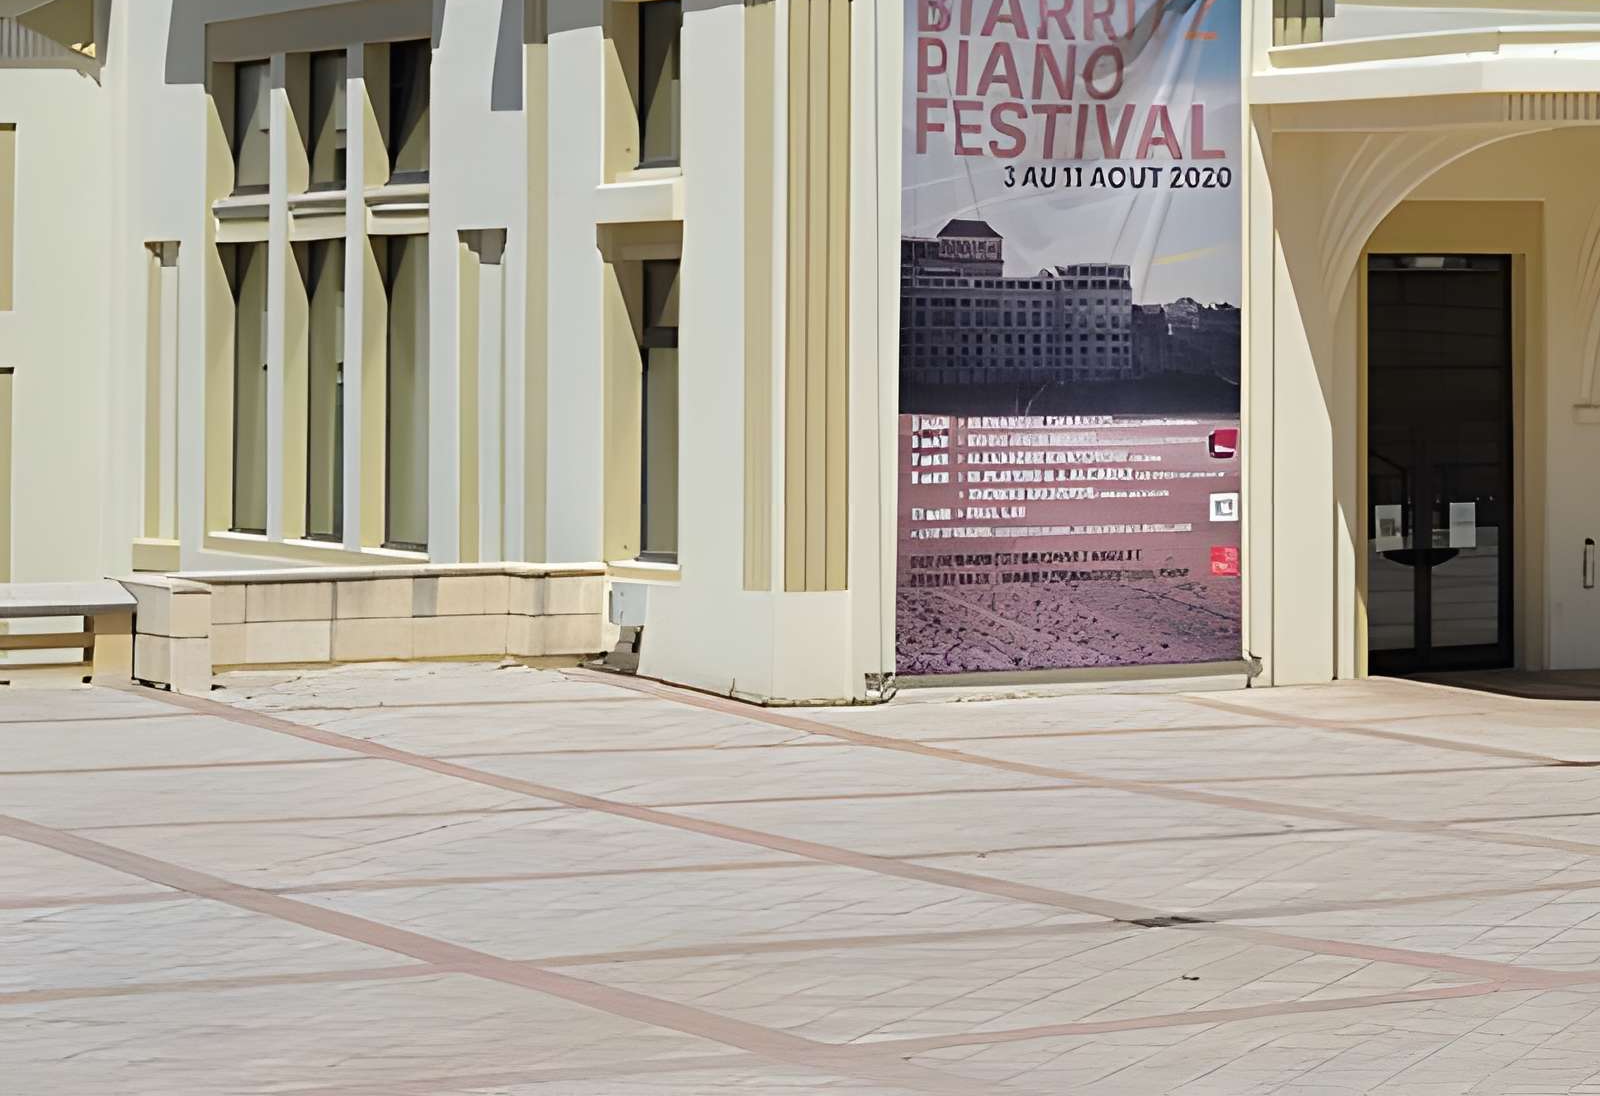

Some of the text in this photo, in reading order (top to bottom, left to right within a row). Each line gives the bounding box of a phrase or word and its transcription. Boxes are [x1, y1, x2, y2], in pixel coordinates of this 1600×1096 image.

[916, 36, 1126, 101] PIANO
[914, 98, 1227, 161] FESTIVAL
[1003, 165, 1233, 189] 3 AU 11 AOUT 2020
